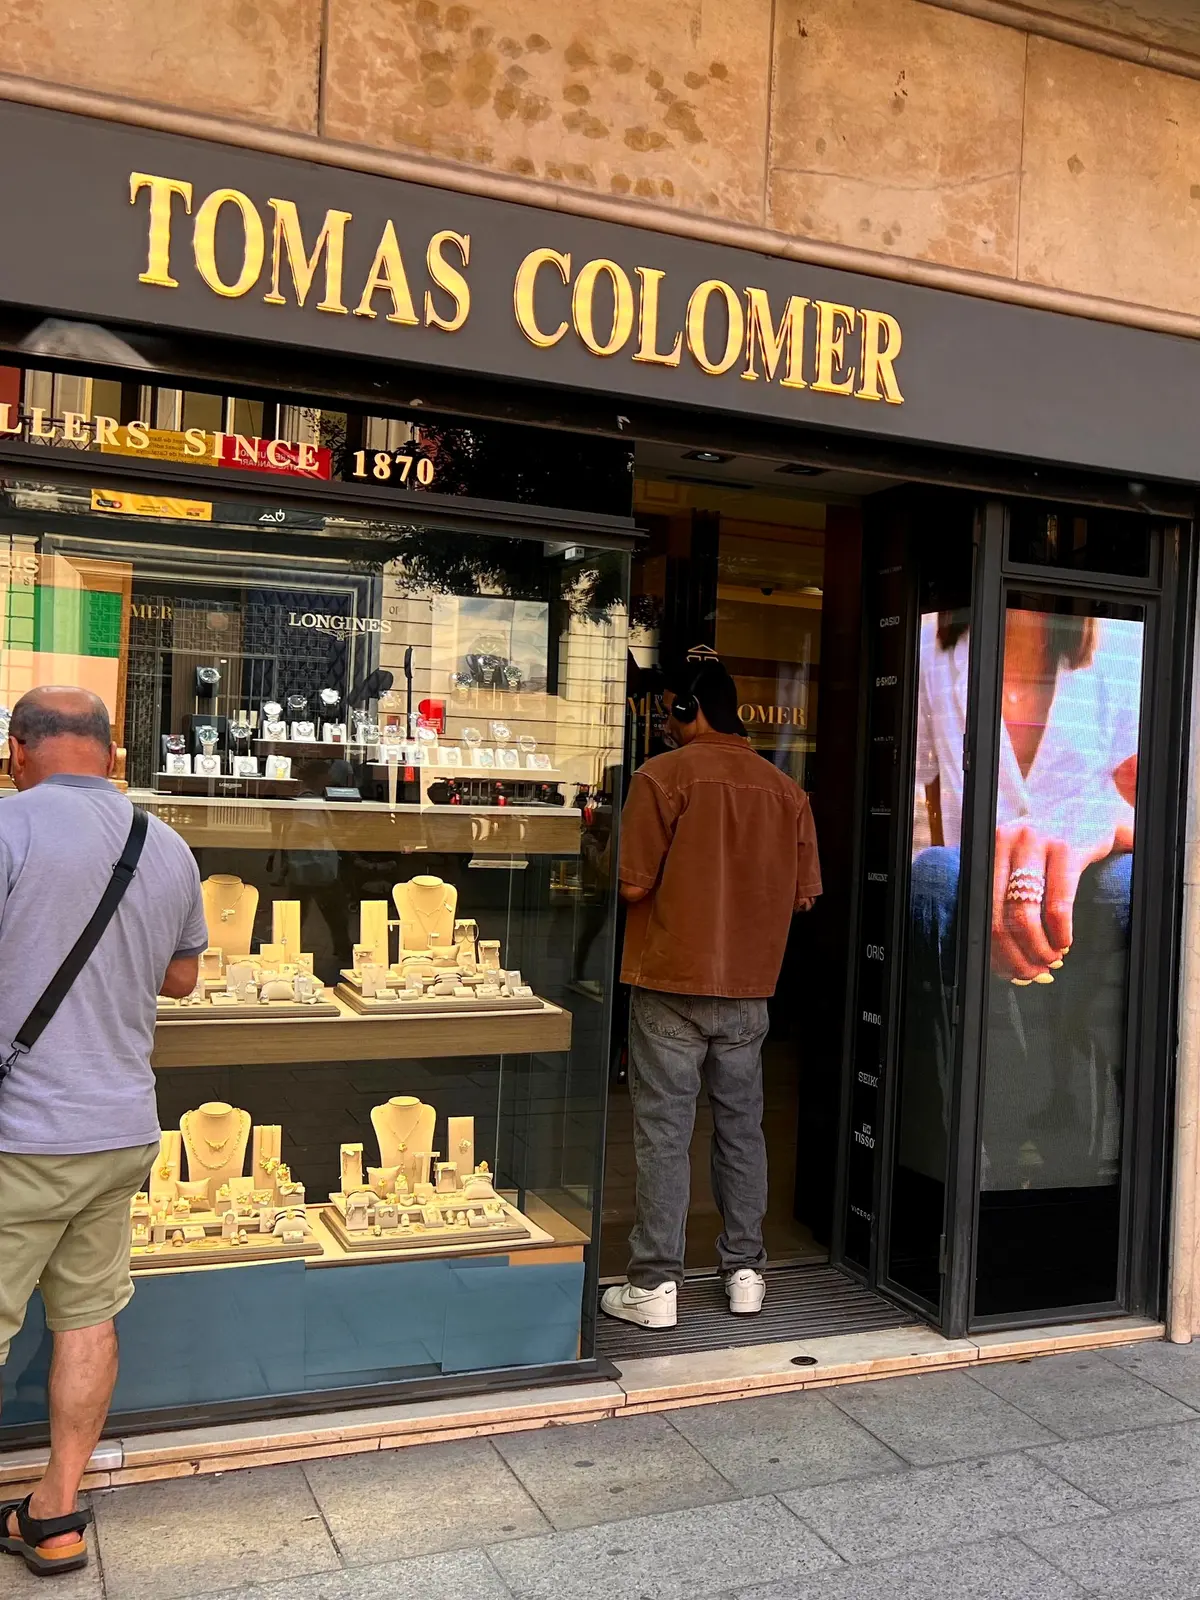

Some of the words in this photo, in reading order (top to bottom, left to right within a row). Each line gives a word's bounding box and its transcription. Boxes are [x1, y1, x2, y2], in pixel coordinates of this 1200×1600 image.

[129, 171, 472, 333] TOMAS
[513, 247, 905, 405] COLOMER
[0, 403, 150, 449] LLERS
[184, 428, 320, 471] SINCE
[352, 450, 435, 485] 1870
[288, 611, 392, 634] LONGINES
[880, 615, 901, 628] CASIO
[866, 944, 885, 962] ORIS
[863, 1010, 882, 1026] RADO
[854, 1131, 876, 1149] TISSO
